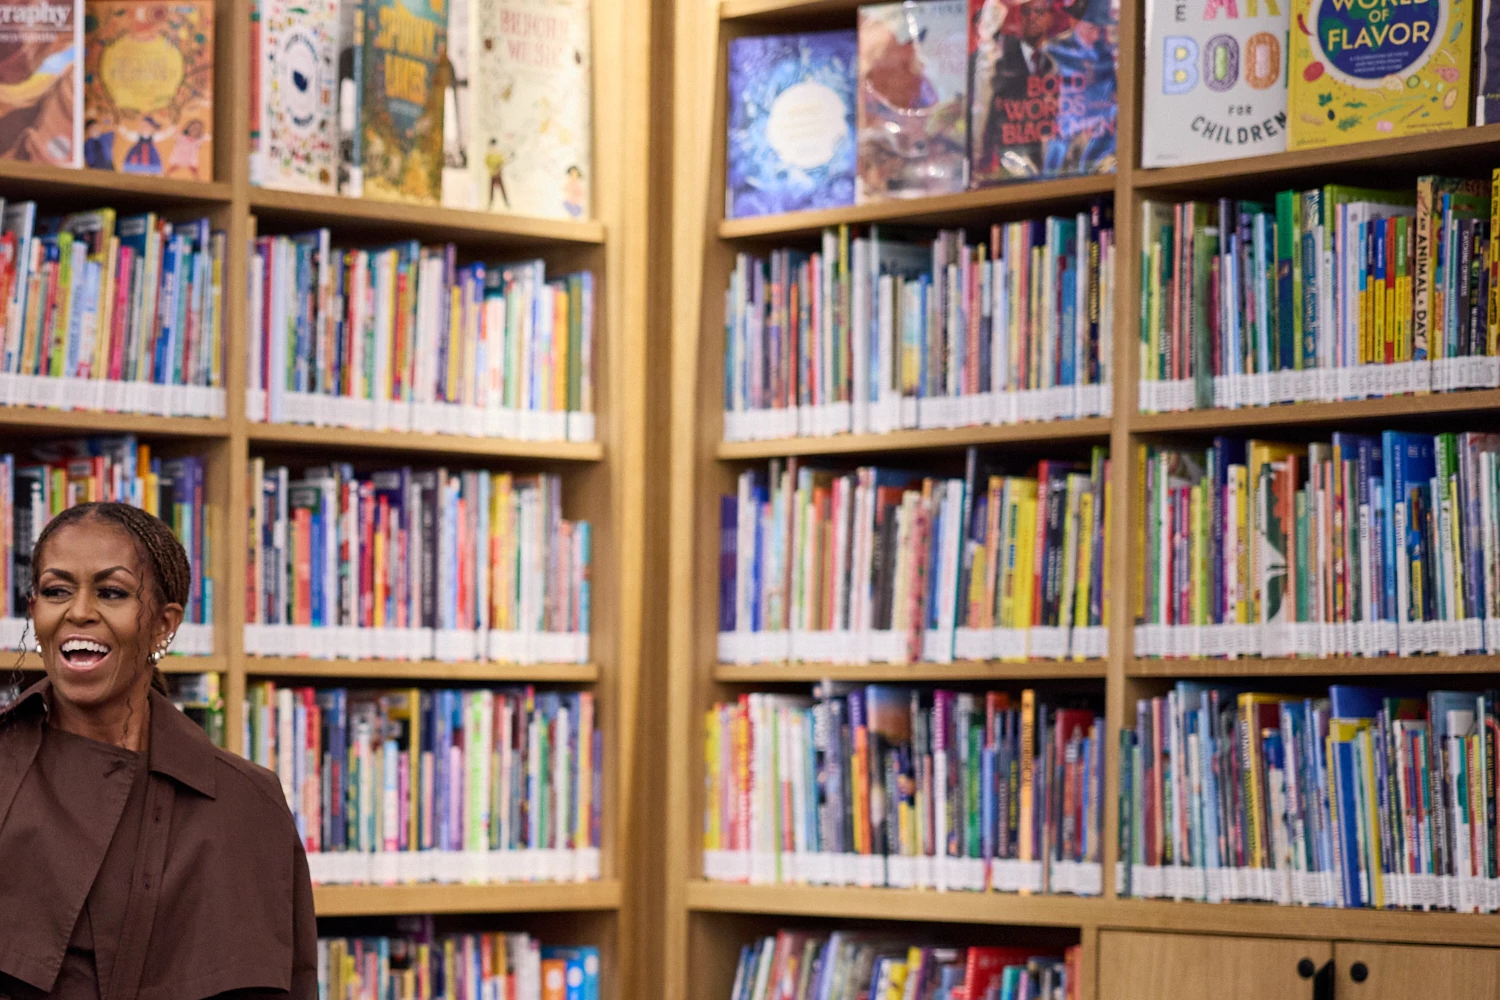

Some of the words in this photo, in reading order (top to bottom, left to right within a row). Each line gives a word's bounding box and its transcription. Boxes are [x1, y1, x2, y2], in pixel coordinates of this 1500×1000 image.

[1367, 9, 1390, 23] OF
[1327, 20, 1430, 52] FLAVOR
[1161, 29, 1288, 96] BOO
[1026, 73, 1086, 98] BOLD
[1228, 104, 1253, 116] FOR
[1002, 120, 1062, 145] BLACK
[1417, 234, 1427, 296] ANIMAL
[1417, 310, 1428, 338] DAY
